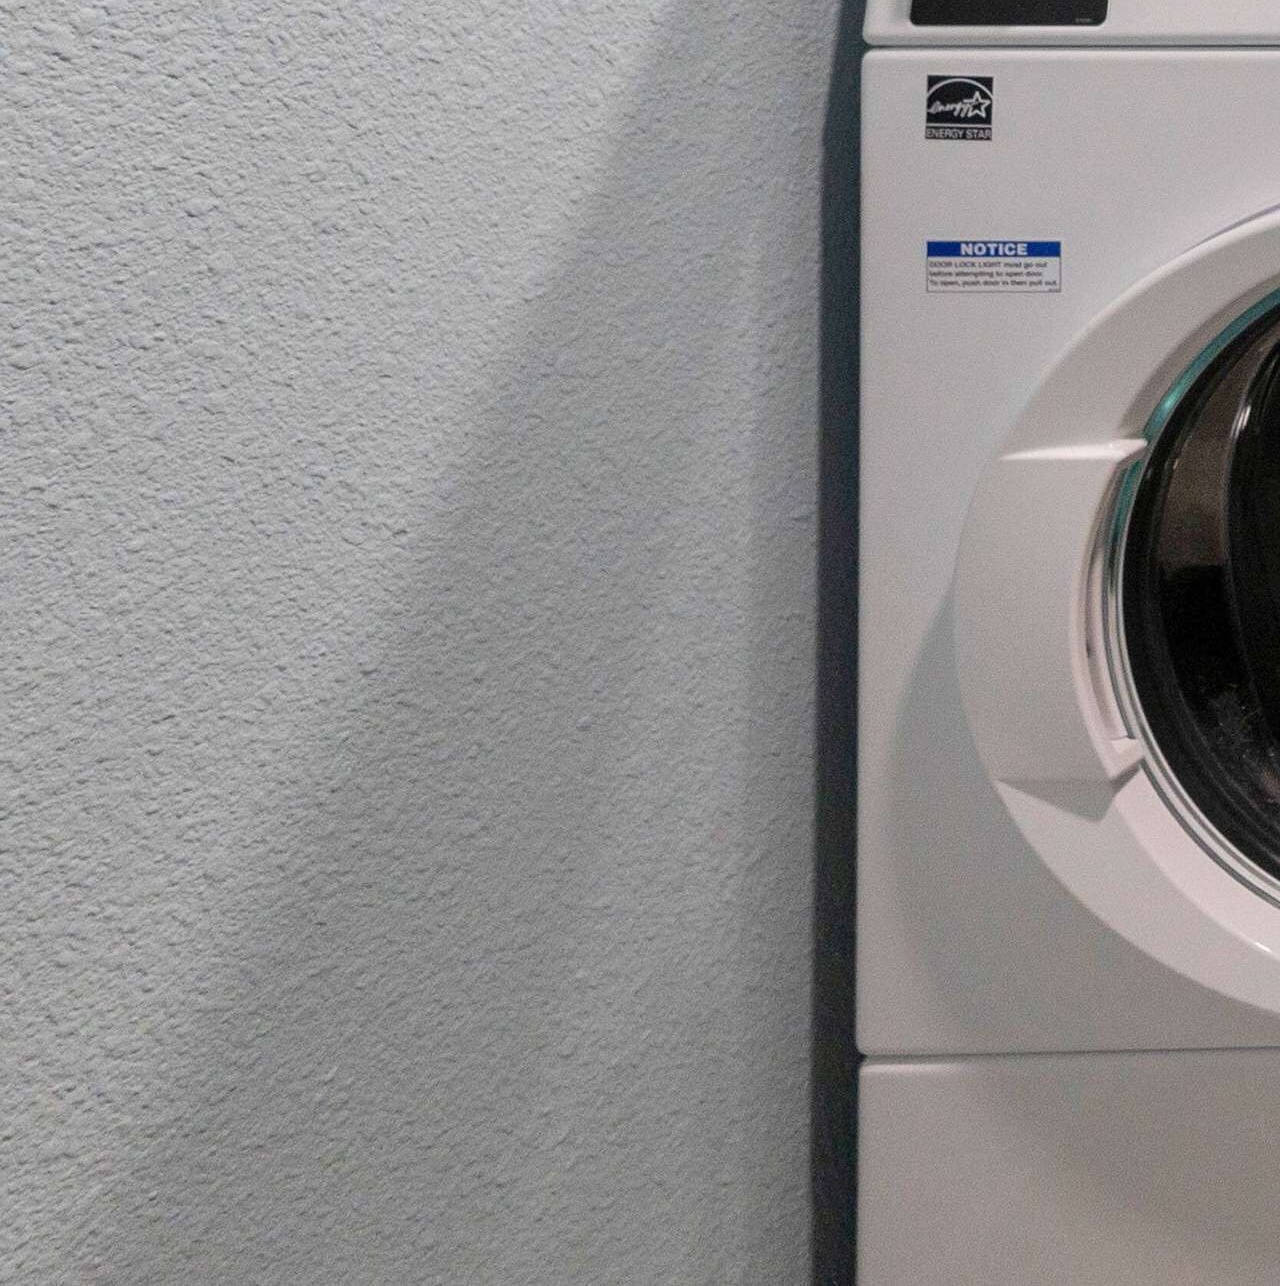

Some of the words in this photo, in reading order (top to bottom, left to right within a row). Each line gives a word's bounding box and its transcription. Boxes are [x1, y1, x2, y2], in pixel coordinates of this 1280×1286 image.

[926, 128, 964, 139] ENERGY
[966, 129, 992, 139] STAR
[960, 243, 1028, 256] NOTICE
